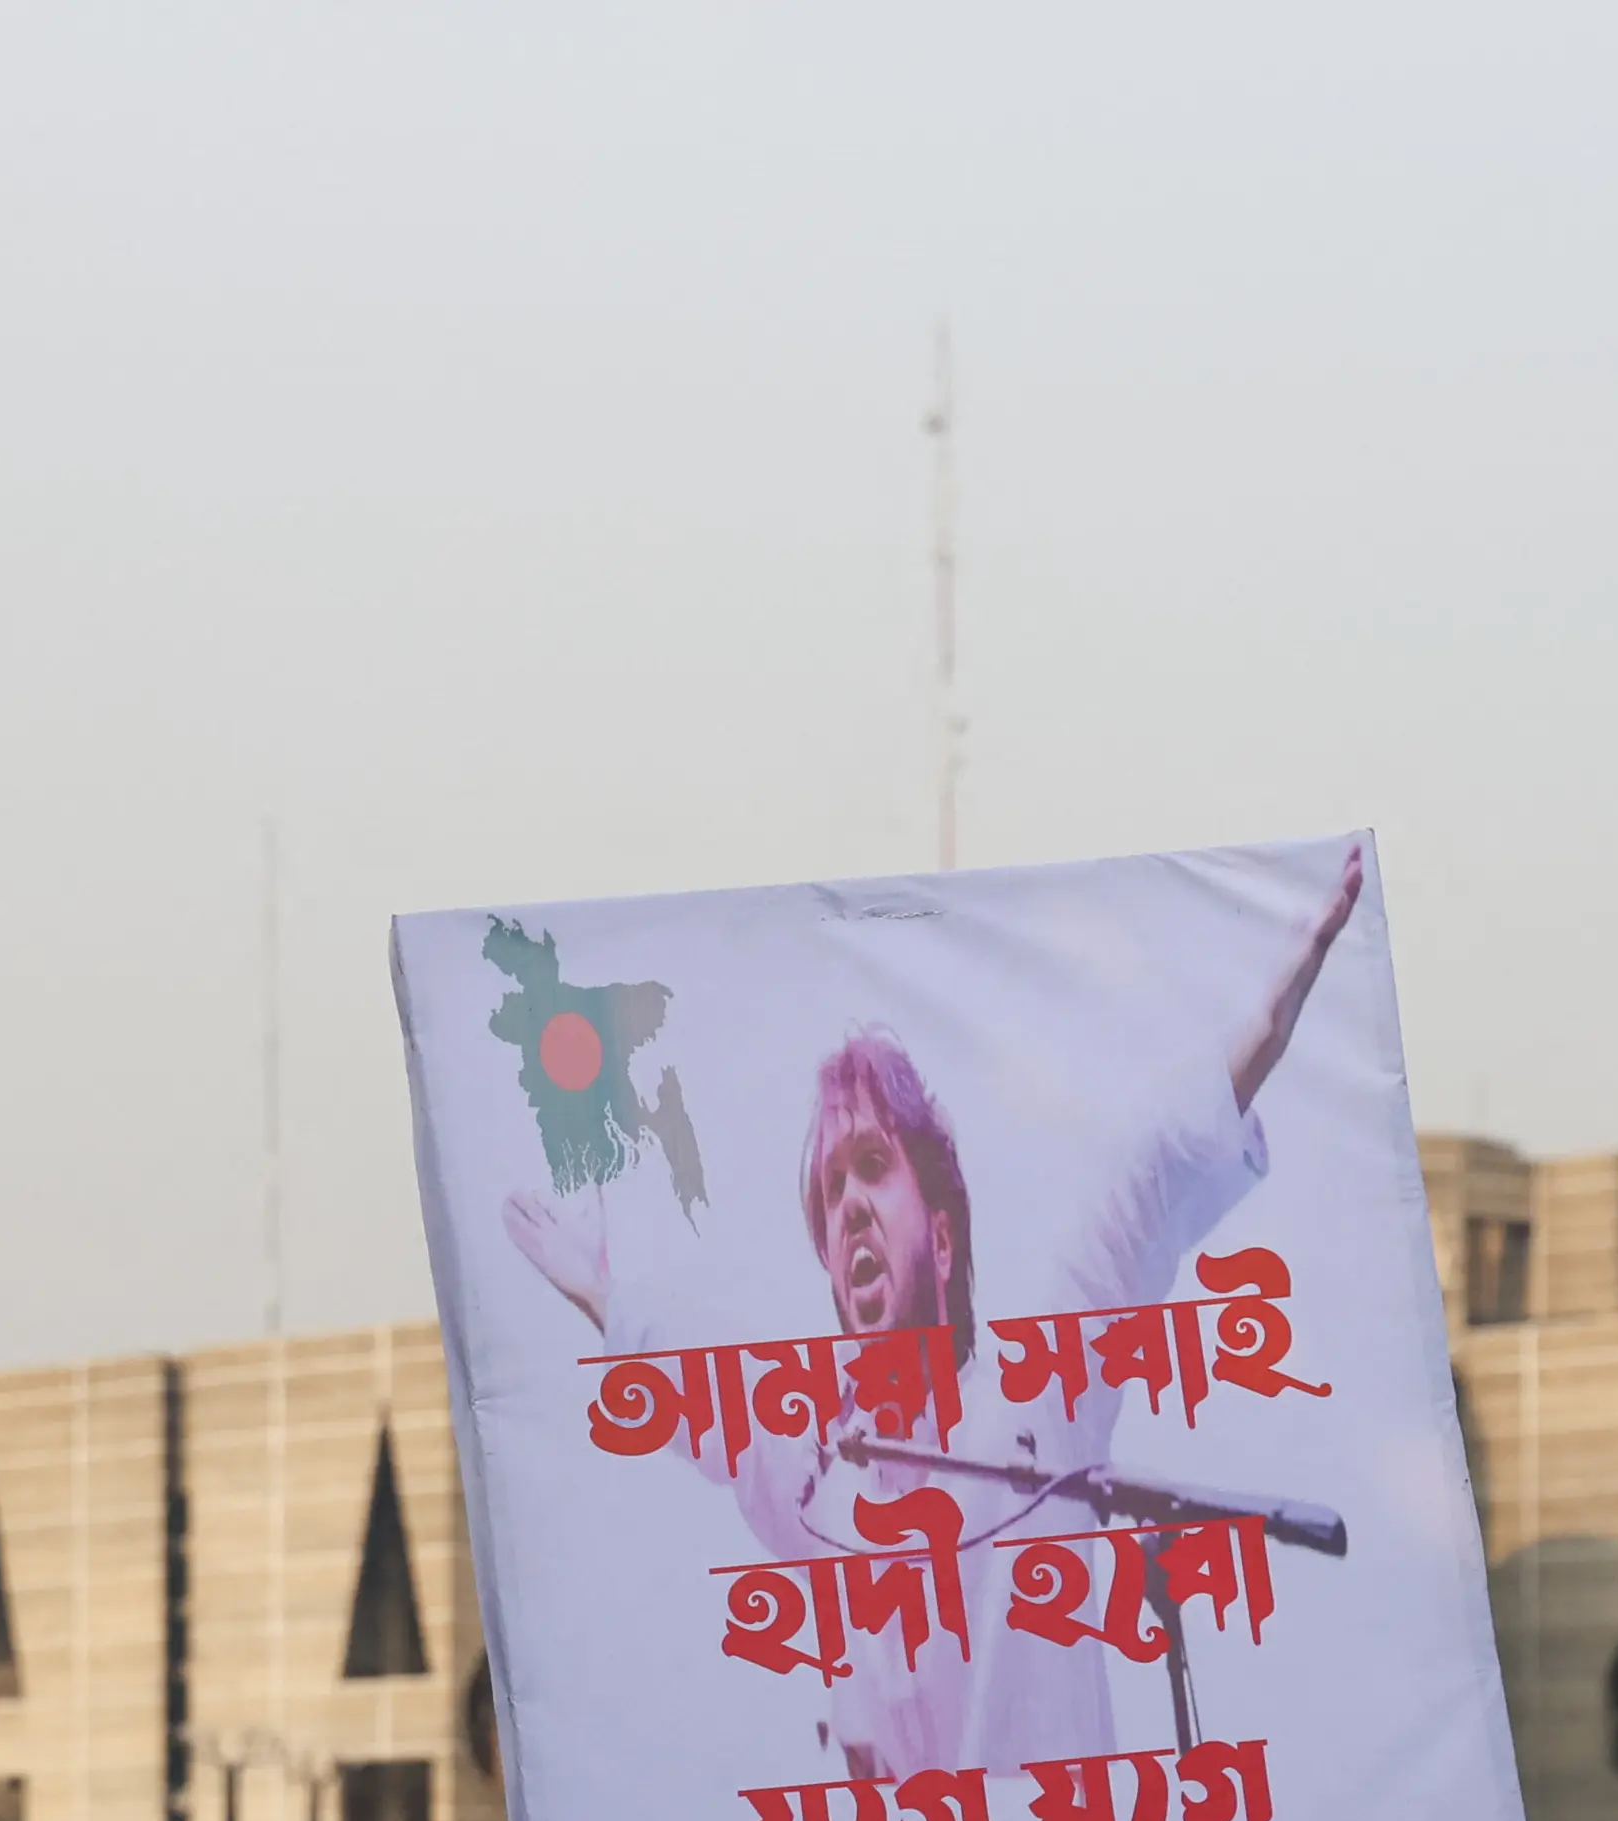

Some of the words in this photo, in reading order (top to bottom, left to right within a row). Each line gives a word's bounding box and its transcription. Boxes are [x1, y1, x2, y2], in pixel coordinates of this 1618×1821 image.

[578, 1325, 962, 1477] আমরা
[987, 1247, 1332, 1429] সবাই
[709, 1487, 970, 1687] হাদী
[993, 1516, 1276, 1663] হবো
